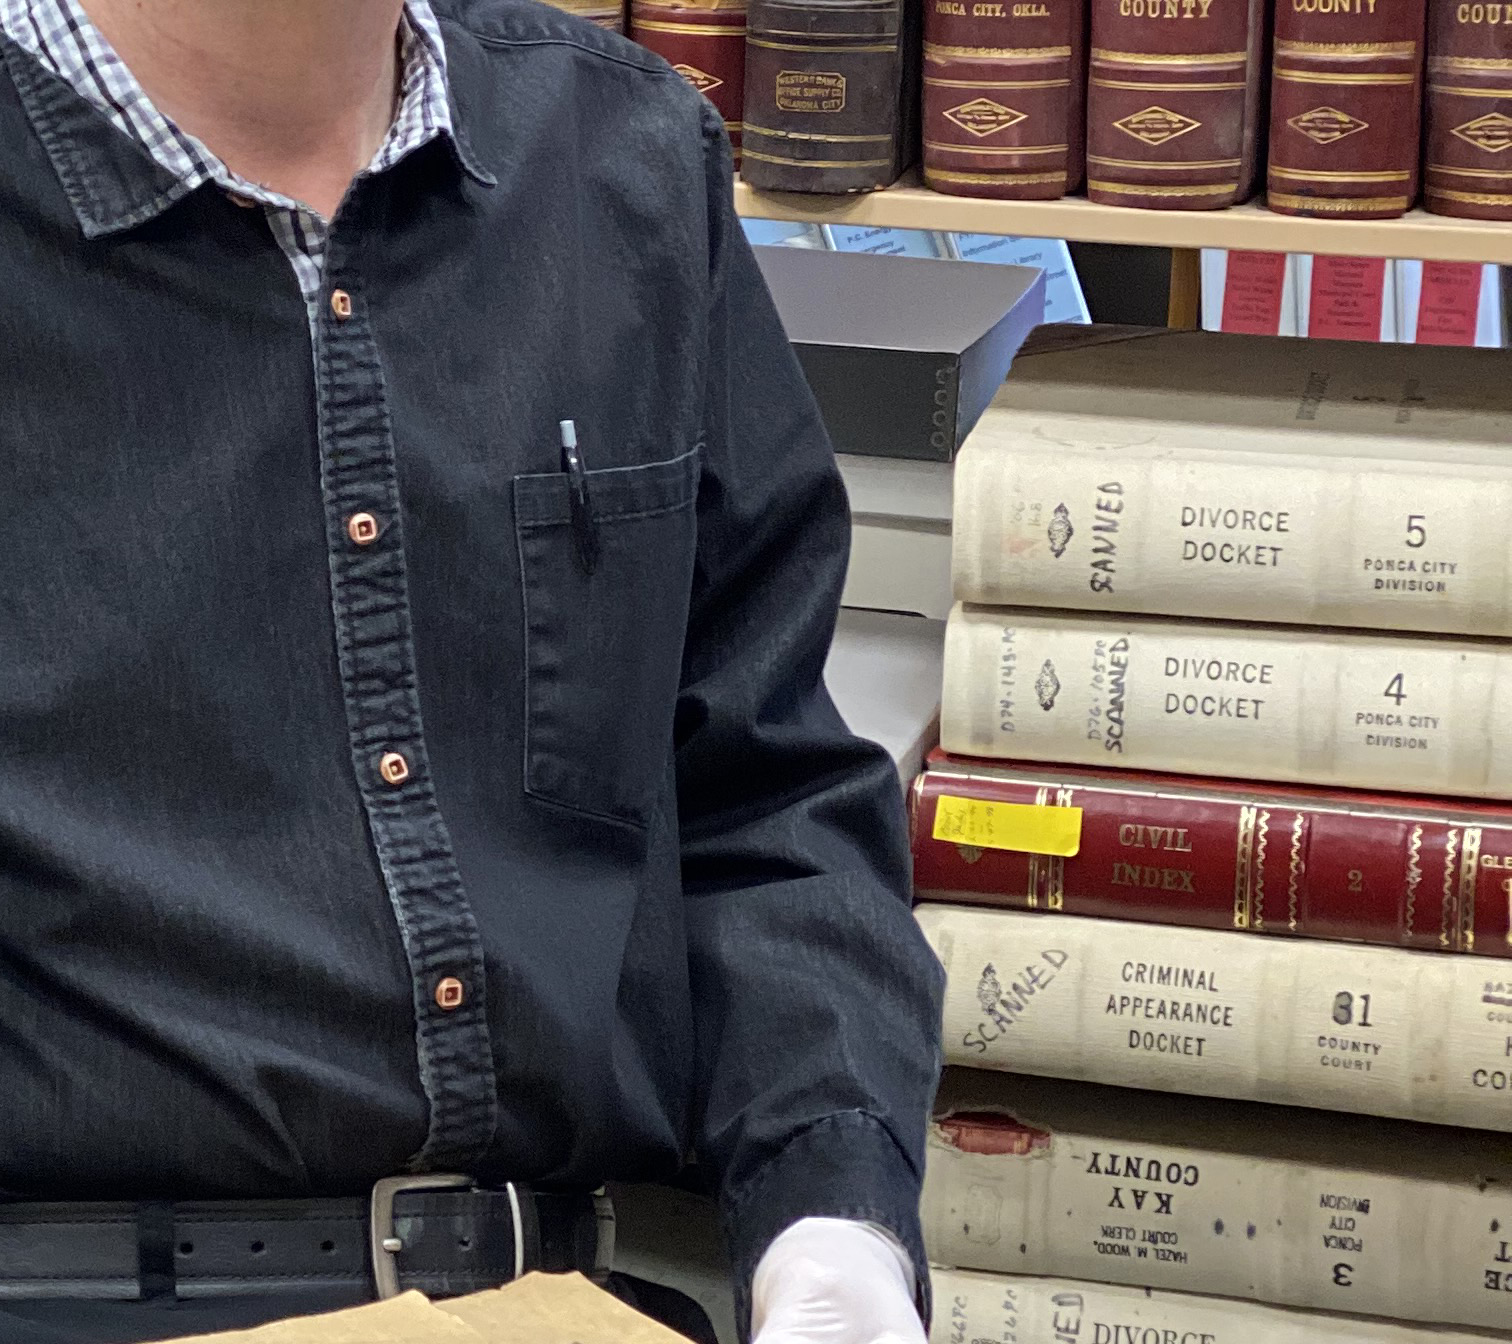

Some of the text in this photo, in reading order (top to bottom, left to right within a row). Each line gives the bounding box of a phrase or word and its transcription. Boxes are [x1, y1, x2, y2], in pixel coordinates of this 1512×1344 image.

[1180, 507, 1290, 533] DIVORCE
[1406, 515, 1427, 549] 5
[1182, 540, 1283, 568] DOCKET
[1364, 558, 1458, 576] PONCA CITY
[1374, 577, 1447, 592] DIVISION
[1164, 657, 1274, 685] DIVORCE
[1384, 673, 1407, 706] 4
[1165, 693, 1266, 721] DOCKET
[1355, 712, 1440, 731] PONCA CITY
[1365, 734, 1428, 751] DIVISION
[1118, 824, 1193, 853] CIVIL
[1111, 863, 1195, 893] INDEX
[1348, 870, 1363, 893] 2
[1121, 961, 1220, 993] CRIMINAL
[962, 948, 1070, 1055] SCANNED
[1105, 994, 1235, 1028] APPEARANCE
[1128, 1029, 1207, 1058] DOCKET
[1318, 1035, 1382, 1056] COUNTY
[1320, 1055, 1373, 1071] COURT
[1086, 1151, 1200, 1186] COUNTY
[1108, 1188, 1174, 1214] KAY
[1155, 1246, 1188, 1264] HAZEL
[1323, 1235, 1363, 1252] PONCA
[1332, 1263, 1353, 1287] 3
